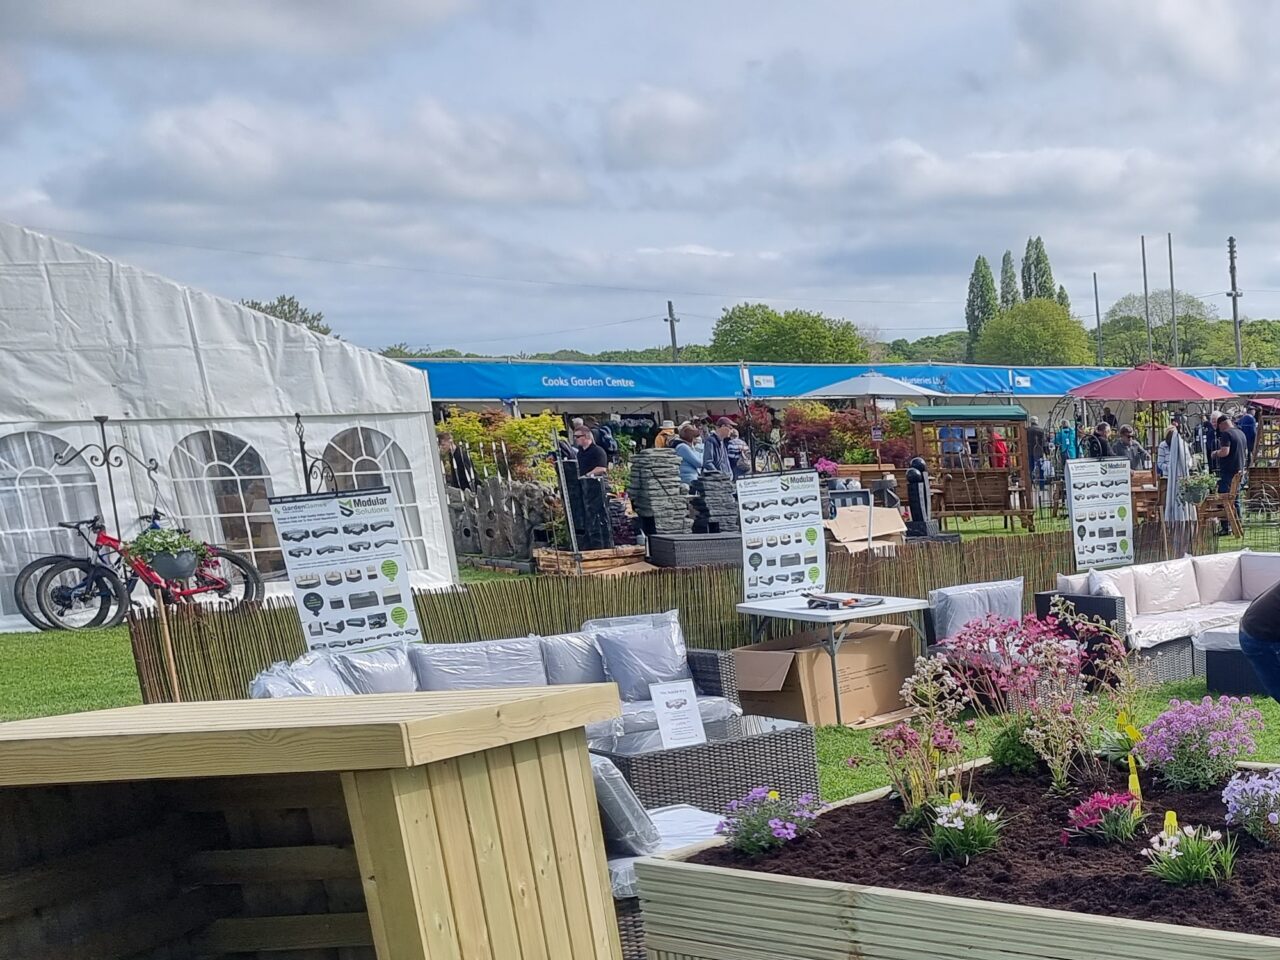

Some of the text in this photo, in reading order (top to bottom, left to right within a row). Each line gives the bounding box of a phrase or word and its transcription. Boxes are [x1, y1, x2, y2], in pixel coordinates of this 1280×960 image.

[542, 376, 635, 387] Cooks Garden Centre
[353, 496, 387, 508] Modular
[355, 506, 389, 515] Solutions
